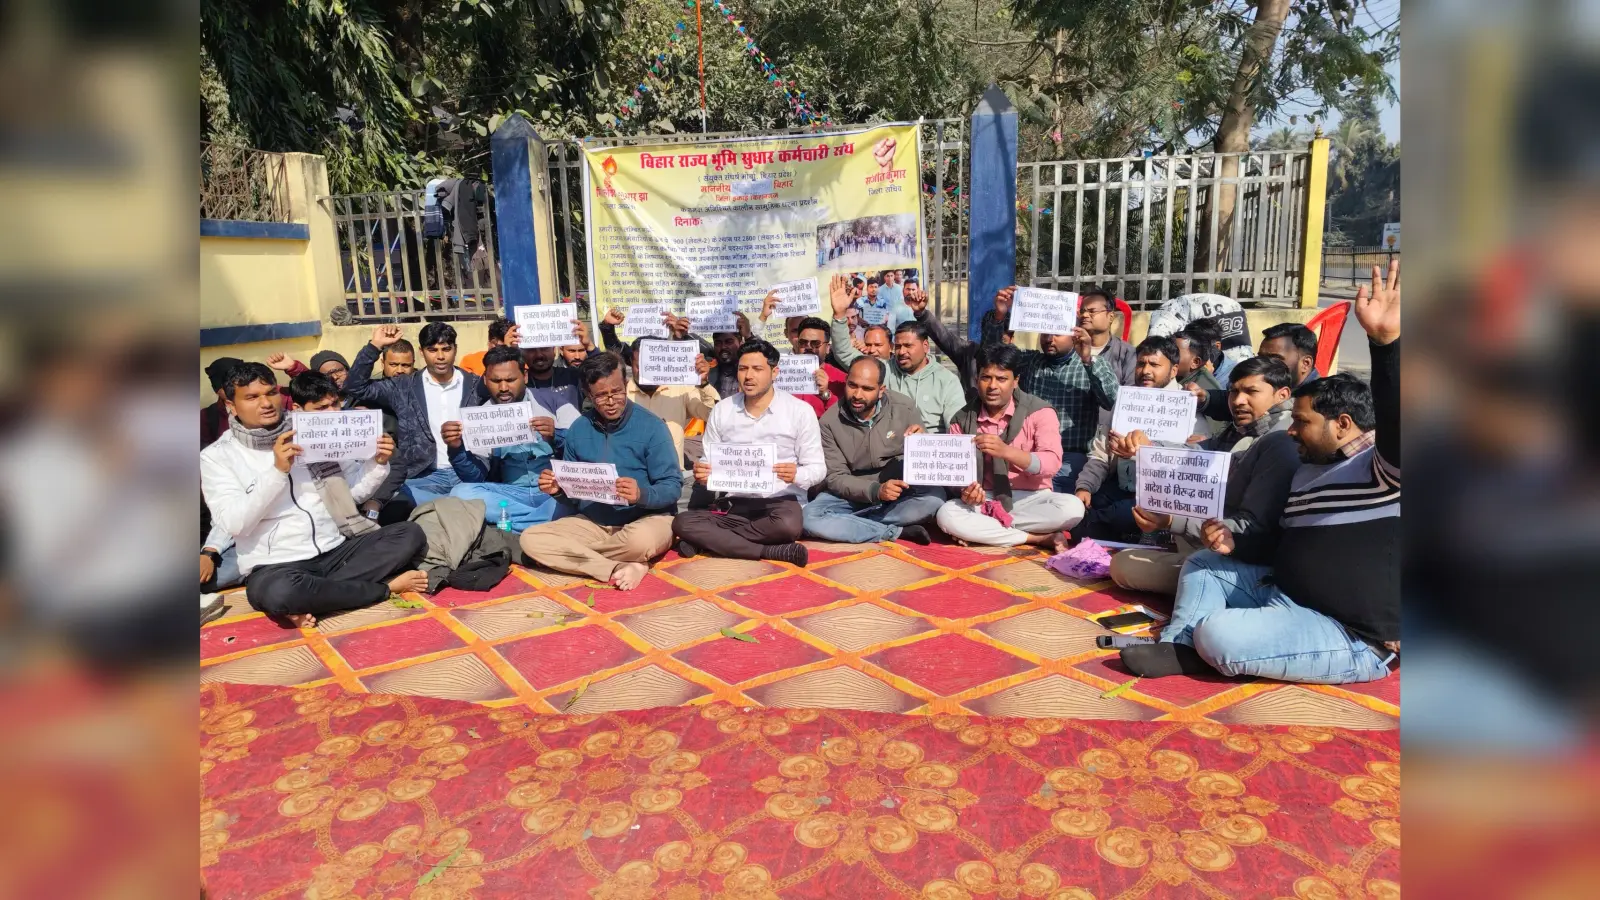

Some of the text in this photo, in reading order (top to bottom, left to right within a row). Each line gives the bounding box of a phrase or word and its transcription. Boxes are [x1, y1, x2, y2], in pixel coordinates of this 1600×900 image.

[640, 153, 674, 168] बिहार
[678, 153, 707, 168] राज्य
[712, 150, 736, 171] भूमि
[742, 152, 774, 170] सुधार
[778, 144, 830, 163] कर्मचारी
[834, 143, 855, 156] संघ
[701, 184, 730, 192] माननीय
[774, 180, 793, 189] बिहार
[1156, 393, 1165, 403] भी
[467, 406, 523, 420] राजस्व कर्मचारी से
[1122, 404, 1145, 412] त्योहार
[1156, 406, 1166, 415] भी
[338, 415, 348, 424] भी
[1157, 419, 1178, 428] इंसान
[301, 428, 328, 439] त्योहार
[342, 428, 351, 437] भी
[344, 440, 366, 449] इंसान
[473, 437, 480, 447] ही
[482, 436, 495, 446] कार्य
[497, 436, 514, 444] लिया
[744, 448, 750, 456] से
[939, 451, 963, 459] राज्यपाल
[965, 450, 970, 459] के
[734, 458, 742, 466] की
[912, 461, 928, 470] आदेश
[929, 461, 935, 470] के
[955, 462, 968, 471] कार्य
[738, 469, 753, 478] जिला
[937, 472, 952, 482] किया
[1141, 468, 1167, 479] अवकाश
[1177, 472, 1208, 484] राज्यपाल
[1210, 473, 1219, 484] के
[744, 480, 749, 488] है
[1144, 483, 1162, 494] आदेश
[1164, 485, 1172, 495] के
[1198, 488, 1214, 500] कार्य
[1148, 496, 1208, 515] लेना बंद किया जाय
